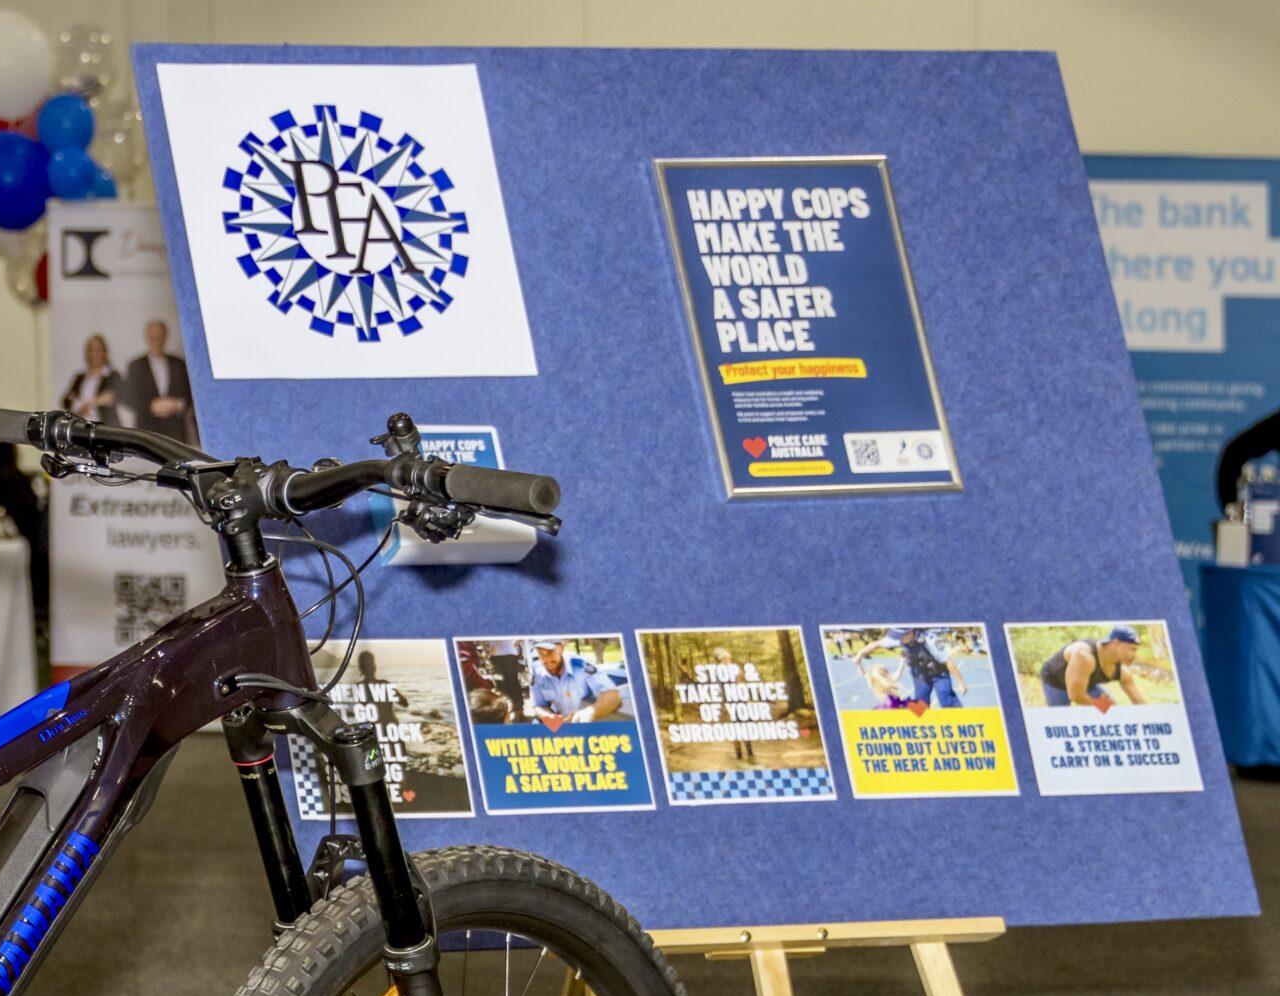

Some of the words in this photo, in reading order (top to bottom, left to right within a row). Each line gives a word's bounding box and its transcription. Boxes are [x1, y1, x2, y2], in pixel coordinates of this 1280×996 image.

[687, 189, 784, 221] HAPPY
[792, 188, 870, 218] COPS
[1092, 195, 1143, 227] he
[1158, 194, 1251, 229] bank
[282, 159, 424, 274] PFA
[694, 222, 781, 253] MAKE
[783, 221, 845, 251] THE
[702, 255, 809, 286] WORLD
[1109, 247, 1194, 281] here
[1207, 253, 1274, 288] you
[714, 289, 735, 319] A
[742, 287, 836, 318] SAFER
[1123, 300, 1207, 341] long
[716, 321, 815, 352] PLACE
[725, 364, 768, 376] Protect
[770, 365, 796, 379] your
[799, 362, 859, 377] happiness
[421, 440, 455, 451] HAPPY
[458, 440, 485, 451] COPS
[768, 436, 800, 447] POLICE
[802, 434, 828, 446] CARE
[455, 452, 476, 462] THE
[772, 447, 824, 458] AUSTRALIA
[695, 664, 739, 682] STOP
[744, 663, 760, 681] &
[368, 684, 400, 702] WE
[675, 683, 722, 703] TAKE
[724, 682, 788, 702] NOTICE
[355, 704, 378, 722] GO
[700, 704, 721, 722] OF
[725, 702, 772, 721] YOUR
[376, 723, 423, 742] LOCK
[669, 721, 799, 742] SURROUNDINGS
[860, 726, 937, 740] HAPPINESS
[941, 725, 954, 738] IS
[958, 724, 984, 738] NOT
[1045, 726, 1079, 738] BUILD
[1083, 725, 1121, 737] PEACE
[1125, 724, 1138, 736] OF
[1143, 723, 1172, 735] MIND
[485, 738, 529, 756] WITH
[531, 737, 584, 755] HAPPY
[588, 735, 632, 753] COPS
[857, 743, 902, 756] FOUND
[906, 742, 932, 755] BUT
[937, 741, 977, 755] LIVED
[981, 740, 995, 753] IN
[1065, 741, 1074, 752] &
[1078, 740, 1141, 752] STRENGTH
[1144, 738, 1160, 750] TO
[508, 756, 541, 774] THE
[542, 754, 616, 773] WORLD'S
[863, 759, 889, 772] THE
[894, 759, 928, 772] HERE
[934, 758, 960, 771] AND
[965, 757, 995, 770] NOW
[1051, 756, 1089, 768] CARRY
[1094, 755, 1111, 767] ON
[1114, 754, 1123, 766] &
[1127, 753, 1180, 766] SUCCEED
[505, 775, 518, 793] A
[520, 774, 573, 792] SAFER
[574, 772, 628, 790] PLACE
